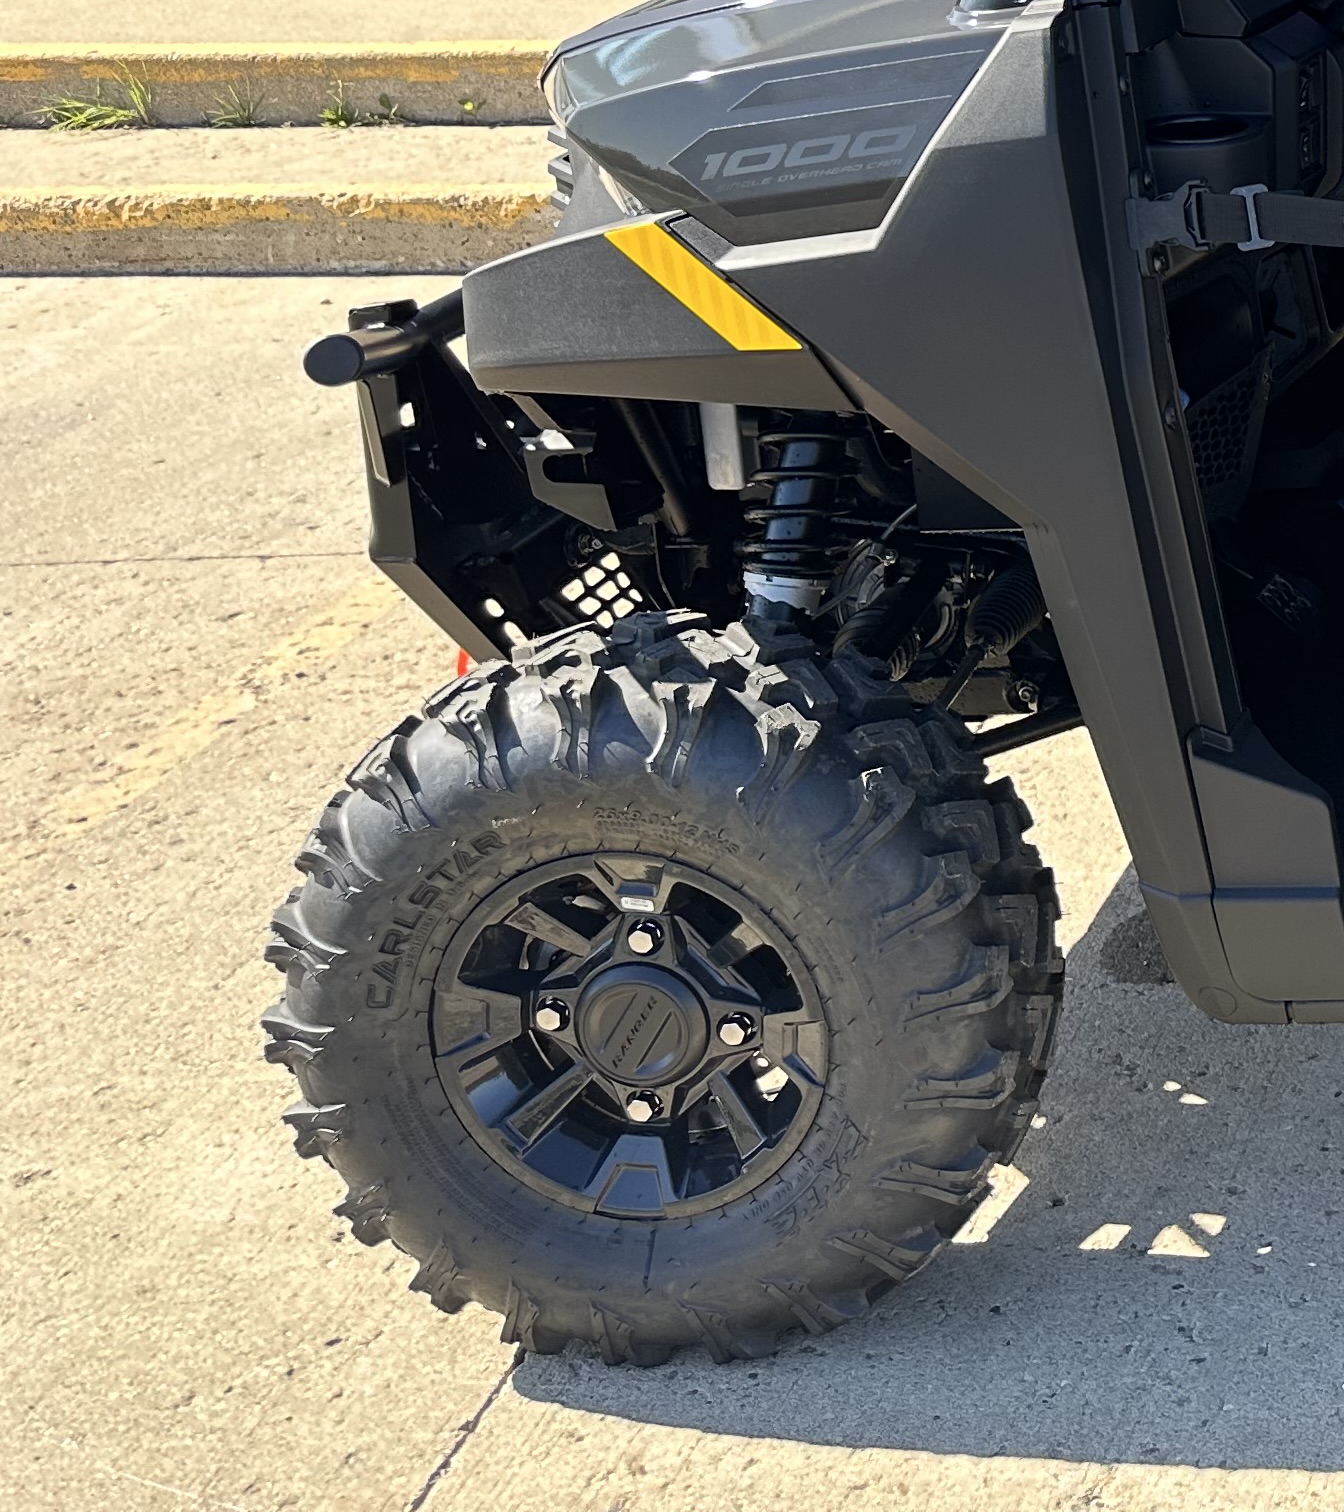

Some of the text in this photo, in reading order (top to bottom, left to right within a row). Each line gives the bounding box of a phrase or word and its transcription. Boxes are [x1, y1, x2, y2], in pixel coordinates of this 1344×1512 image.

[699, 123, 918, 182] 1000
[776, 162, 866, 183] OVERHEAD
[866, 157, 902, 171] CAM
[366, 829, 508, 1010] CARLSTAR
[611, 995, 658, 1069] RANGER
